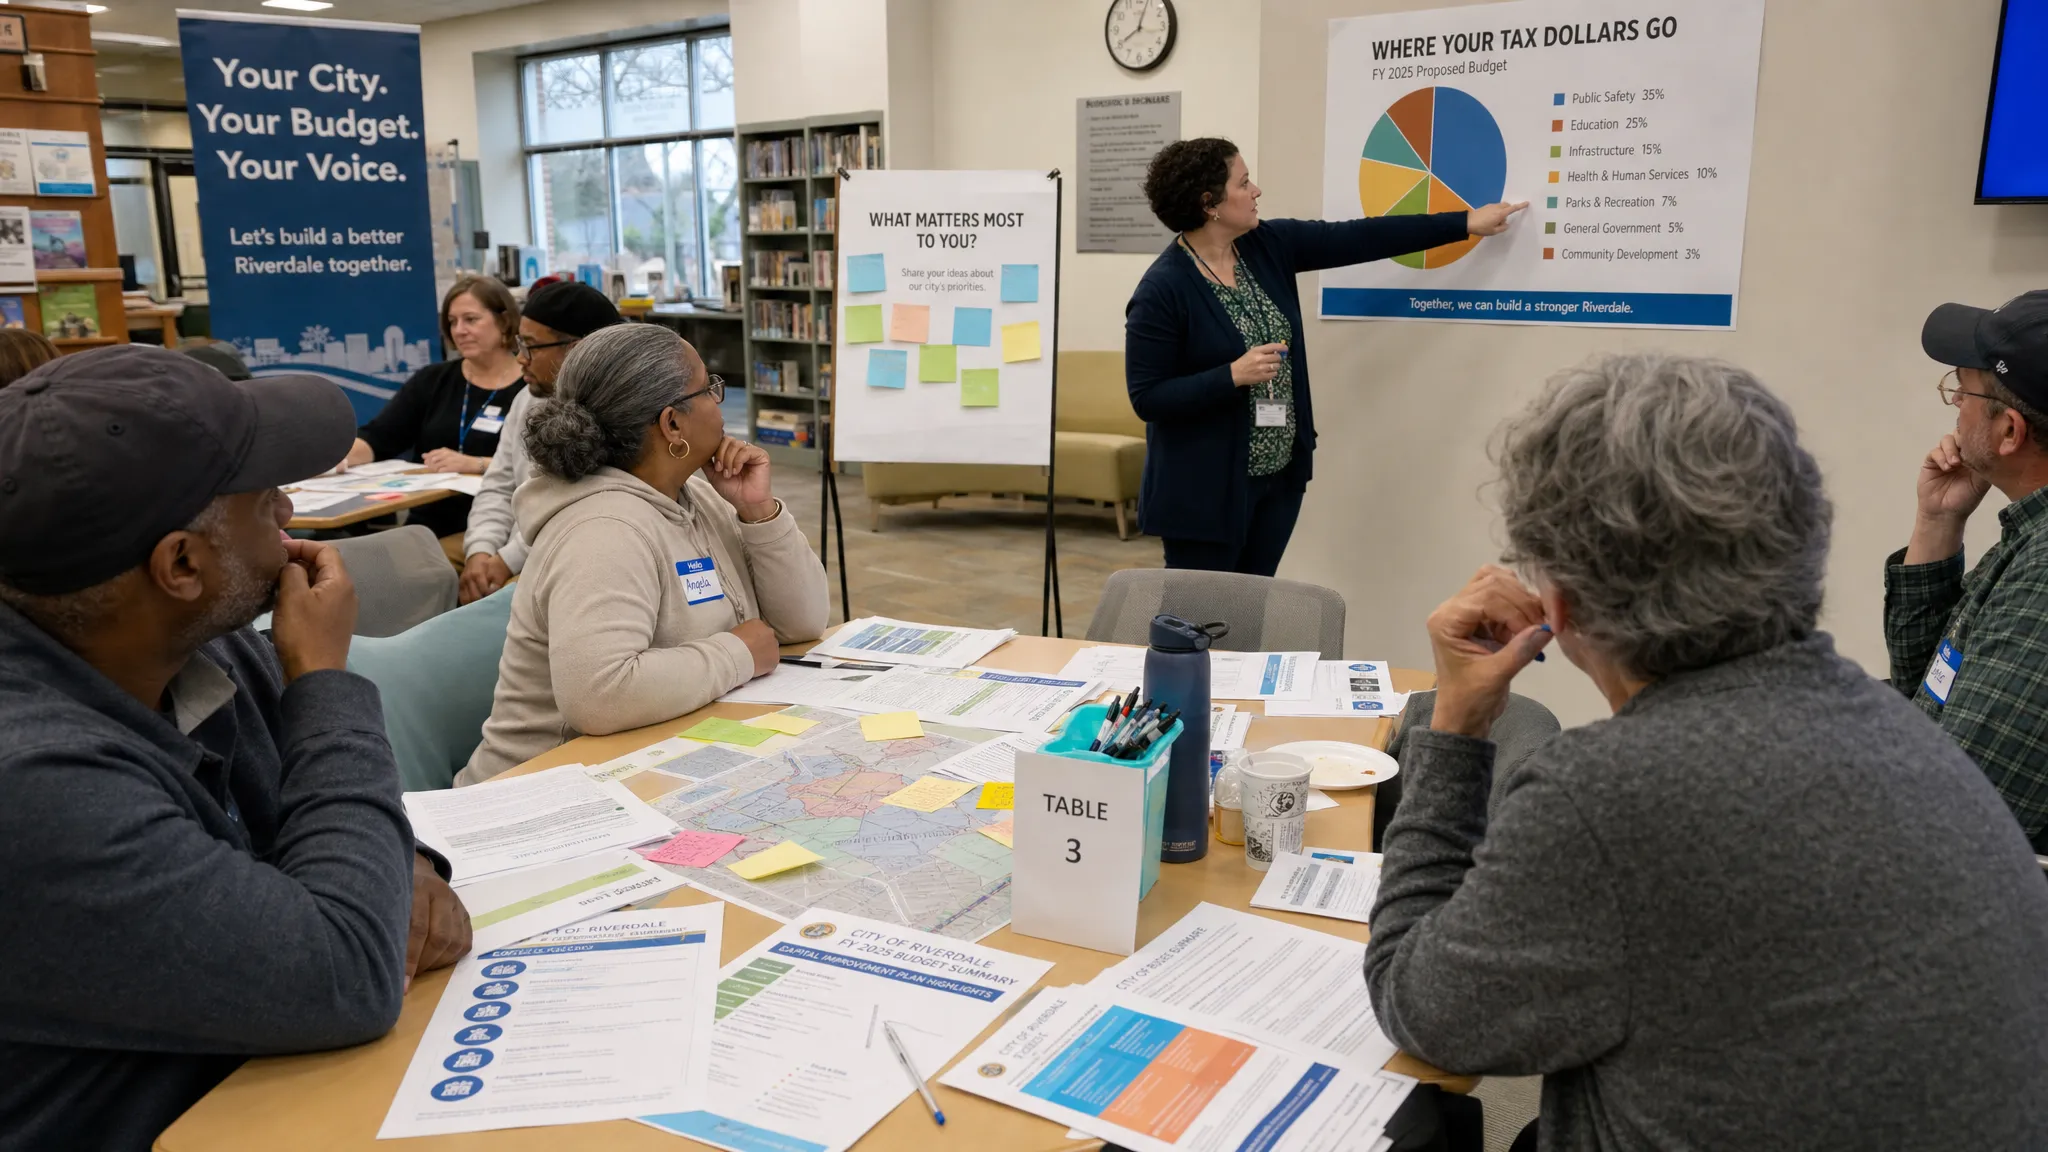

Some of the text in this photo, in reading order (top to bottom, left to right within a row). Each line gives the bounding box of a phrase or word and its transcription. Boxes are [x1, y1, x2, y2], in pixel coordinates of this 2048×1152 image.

[1372, 16, 1678, 60] WHERE YOUR TAX DOLLARS GO
[1372, 59, 1508, 80] FY 2025 Proposed Budget
[212, 57, 388, 101] Your City.
[1572, 88, 1664, 104] Public Safety 35%
[196, 103, 419, 146] Your Budget.
[1570, 117, 1648, 130] Education 25%
[1569, 144, 1662, 156] Infrastructure 15%
[216, 150, 407, 182] Your Voice.
[1568, 168, 1717, 182] Health & Human Services 10%
[1566, 196, 1677, 208] Parks & Recreation 7%
[869, 212, 1024, 228] WHAT MATTERS MOST
[1564, 222, 1684, 234] General Government 5%
[280, 228, 326, 246] build
[332, 233, 343, 245] a
[348, 227, 404, 245] better
[916, 234, 977, 248] TO YOU?
[1562, 248, 1700, 262] Community Development 3%
[235, 256, 412, 277] Riverdale together.
[901, 268, 994, 281] Share your ideas about
[909, 283, 923, 291] our
[947, 281, 987, 293] priorities.
[1409, 298, 1633, 315] Together, we can build a stronger Riverdale.
[1043, 793, 1108, 821] TABLE
[1065, 838, 1082, 863] 3
[589, 921, 667, 933] RIVERDALE
[851, 929, 995, 969] CITY OF RIVERDALE
[838, 939, 1019, 986] FY 2025 BUDGET SUMMARY
[896, 970, 926, 984] PLAN
